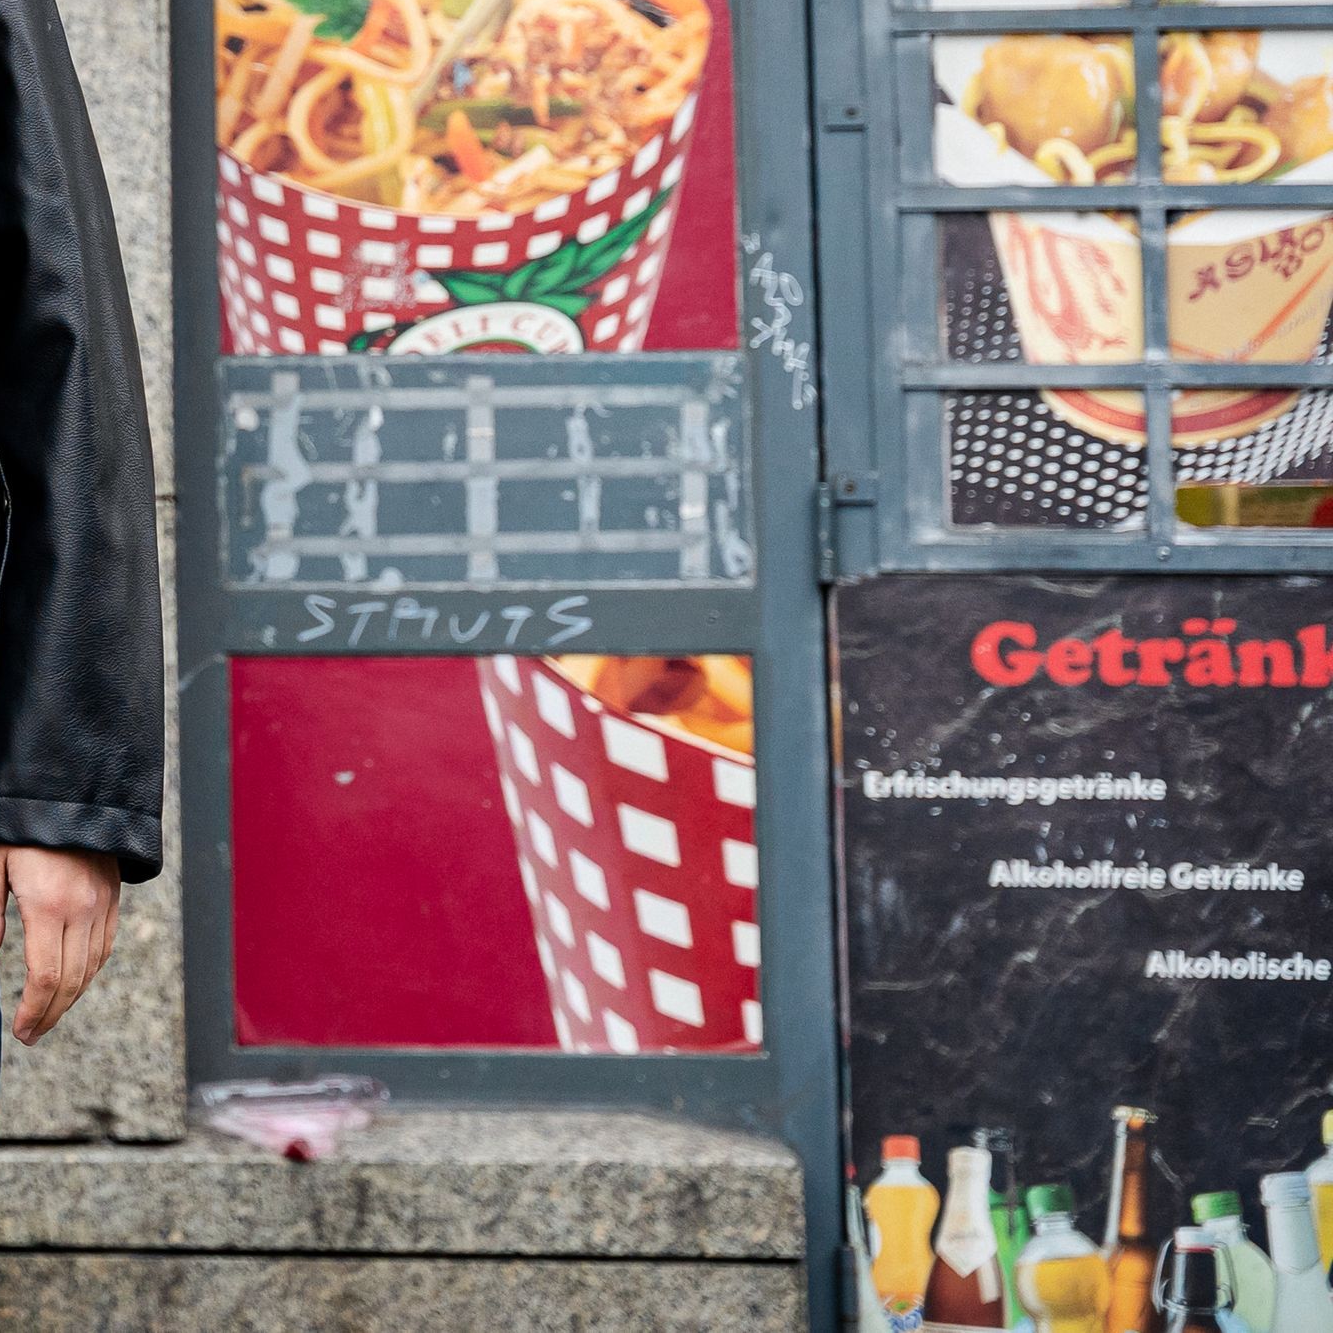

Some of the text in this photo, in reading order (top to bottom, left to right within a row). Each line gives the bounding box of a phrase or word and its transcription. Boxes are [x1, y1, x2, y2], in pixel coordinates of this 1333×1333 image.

[971, 617, 1333, 688] Getränk
[862, 770, 1168, 806] Erfrischungsgetränke
[988, 858, 1306, 892] Alkoholfreie Getränke
[1144, 949, 1332, 982] Alkoholische
